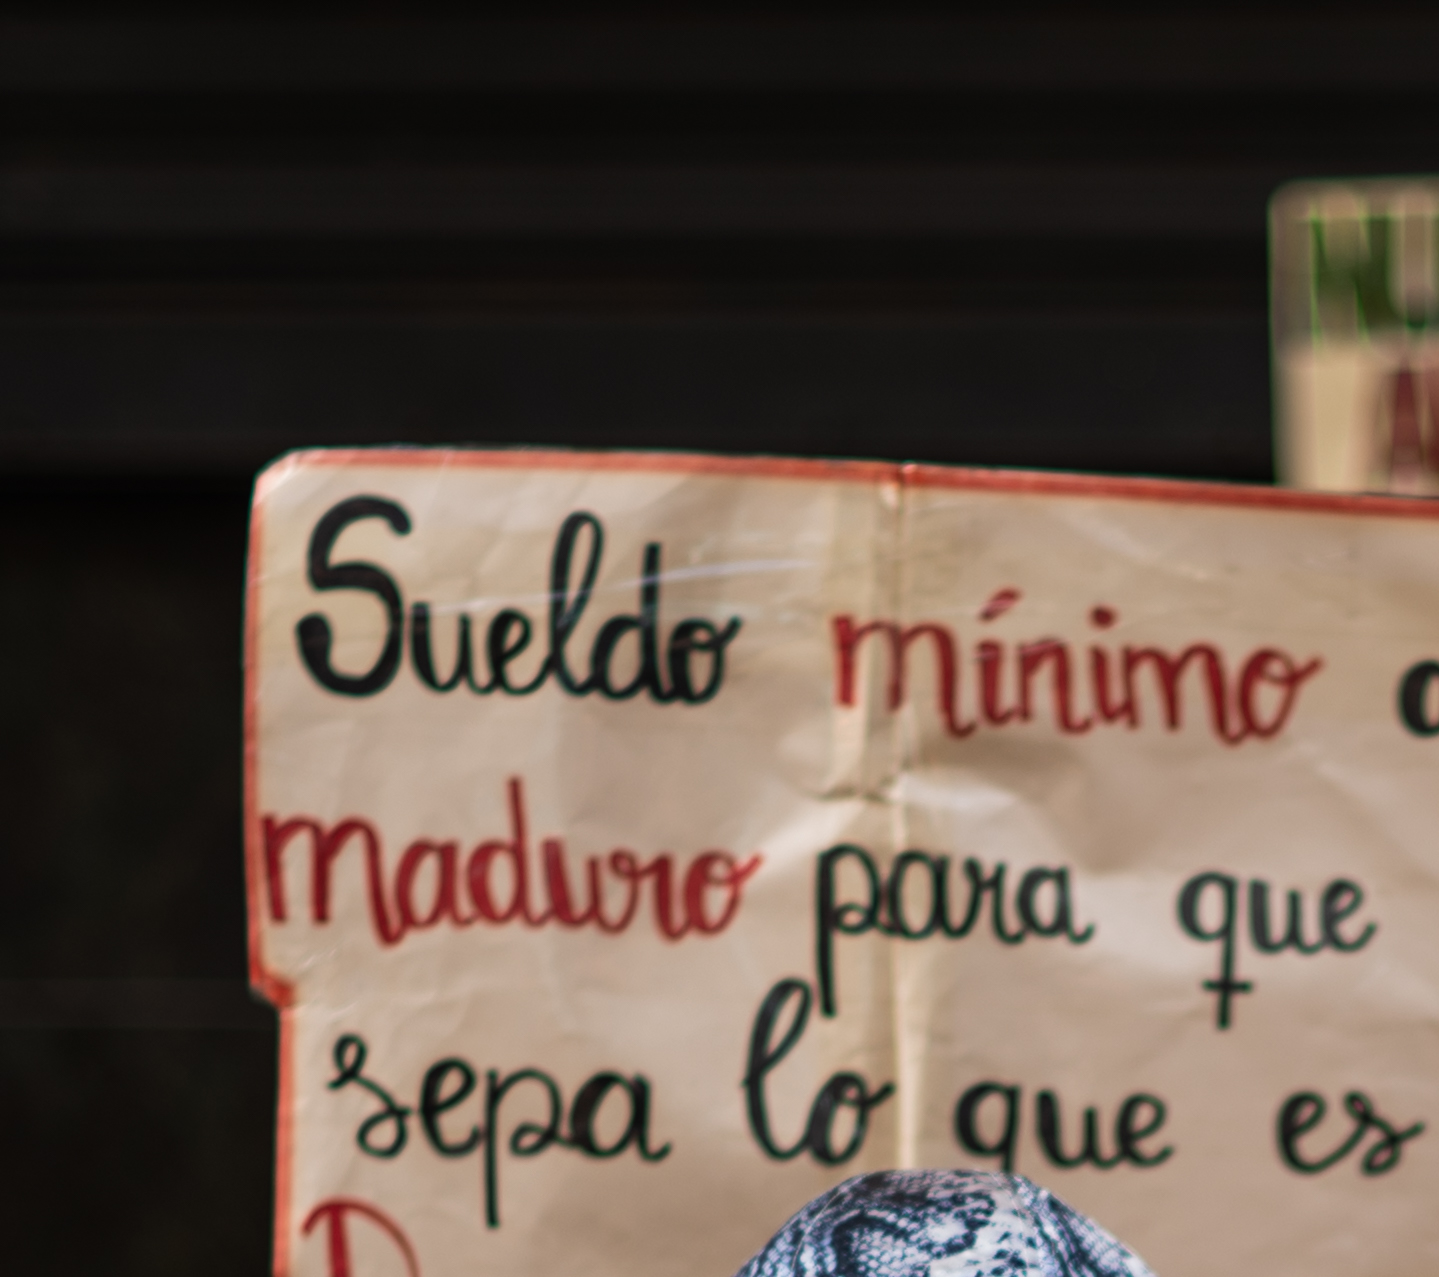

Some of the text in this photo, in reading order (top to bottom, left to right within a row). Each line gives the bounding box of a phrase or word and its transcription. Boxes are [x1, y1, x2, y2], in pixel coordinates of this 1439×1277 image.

[294, 493, 744, 707] Sueldo
[830, 587, 1324, 747] mínimo
[258, 775, 1380, 1031] maduro para que
[326, 975, 1427, 1230] sepa lo que es
